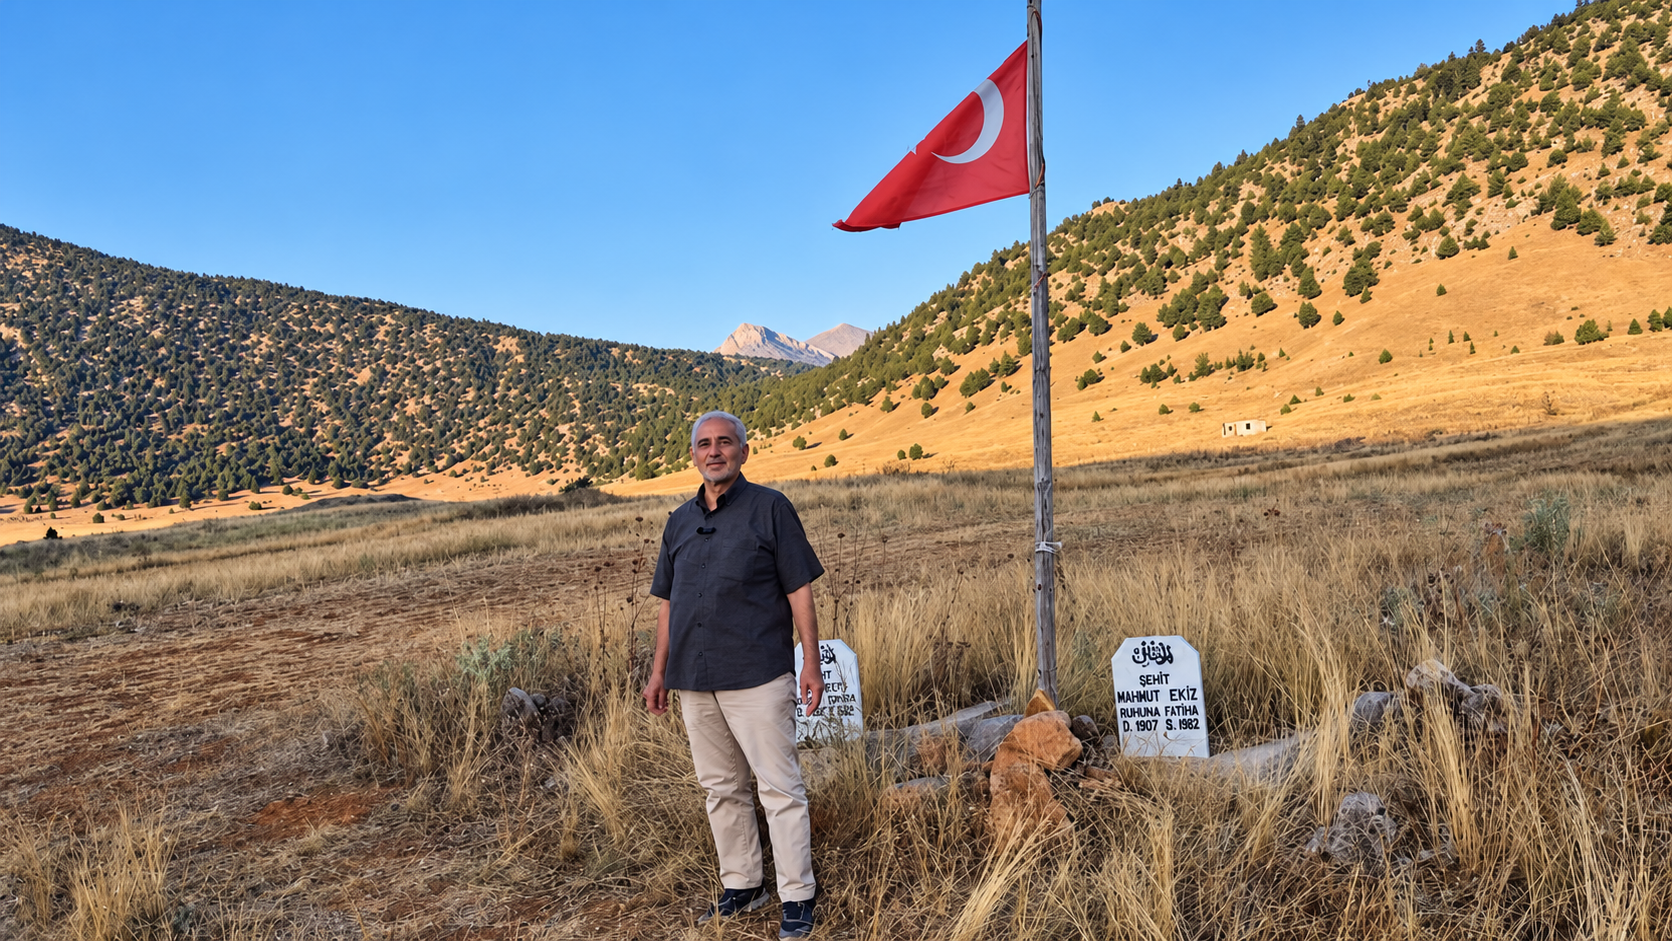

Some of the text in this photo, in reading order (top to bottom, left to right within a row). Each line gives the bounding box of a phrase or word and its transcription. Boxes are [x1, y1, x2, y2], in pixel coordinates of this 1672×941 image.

[1139, 671, 1170, 687] ŞEHİT
[1117, 685, 1198, 704] MAHMUT EKİZ
[1120, 703, 1199, 719] RUHUNA FATİHA
[1122, 718, 1200, 732] D. 1907 S. 1982
